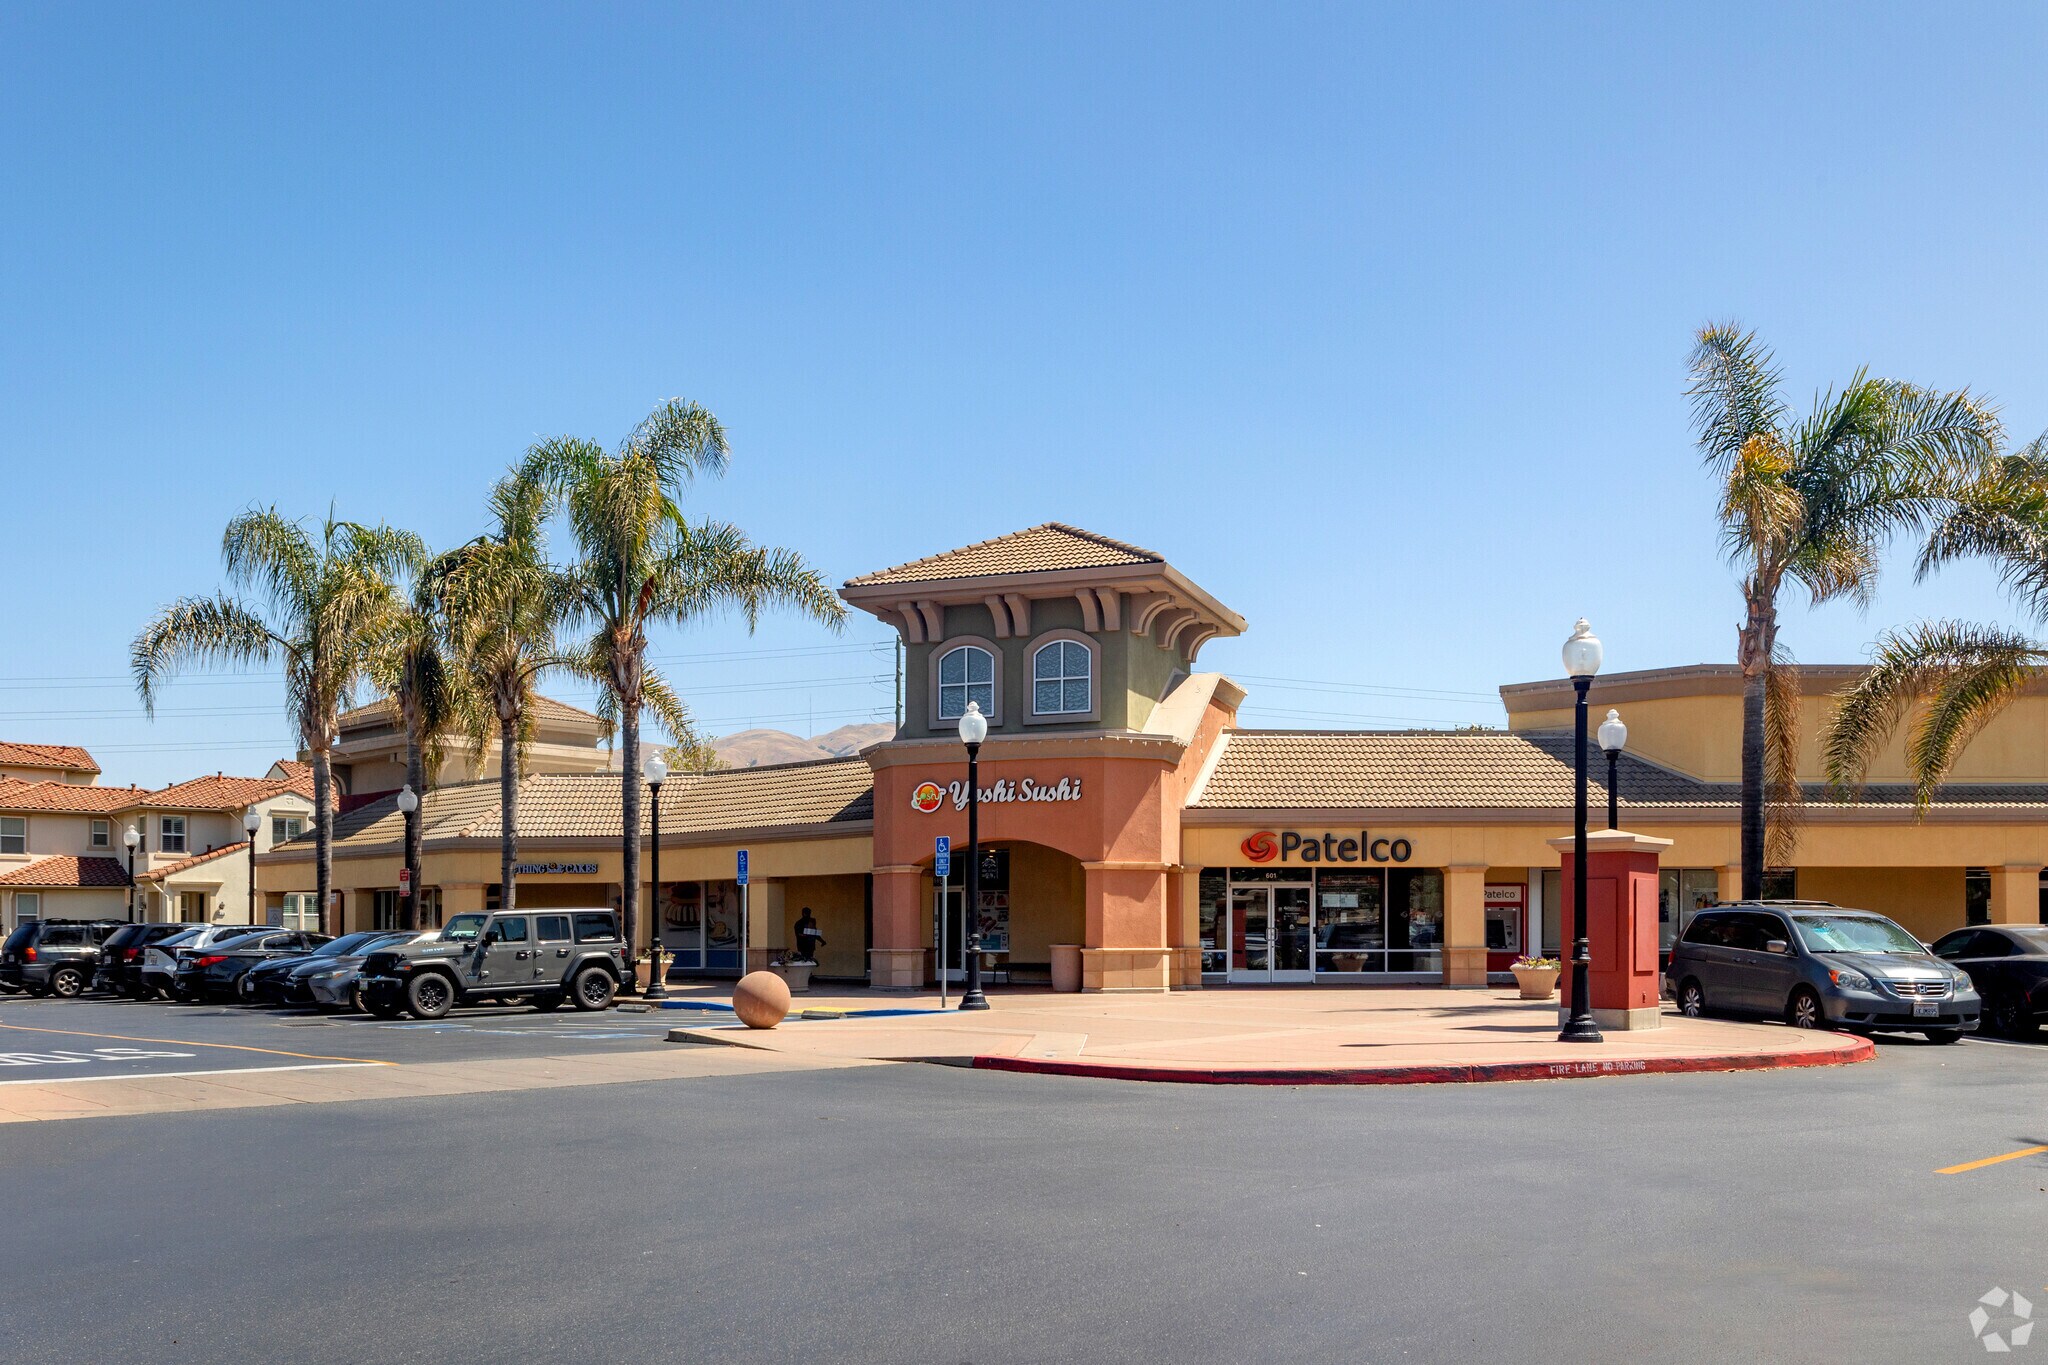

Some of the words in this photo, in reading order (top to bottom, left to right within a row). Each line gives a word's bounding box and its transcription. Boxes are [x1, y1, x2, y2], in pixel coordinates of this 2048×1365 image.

[949, 779, 1016, 811] Yshi
[1018, 777, 1082, 802] Sushi
[1281, 831, 1412, 862] Patelco
[517, 864, 545, 874] THING
[565, 864, 597, 874] CAKES
[1549, 1065, 1571, 1075] FIRE
[1575, 1063, 1598, 1073] LANE
[1602, 1061, 1614, 1071] NO
[1616, 1061, 1646, 1071] PARKING
